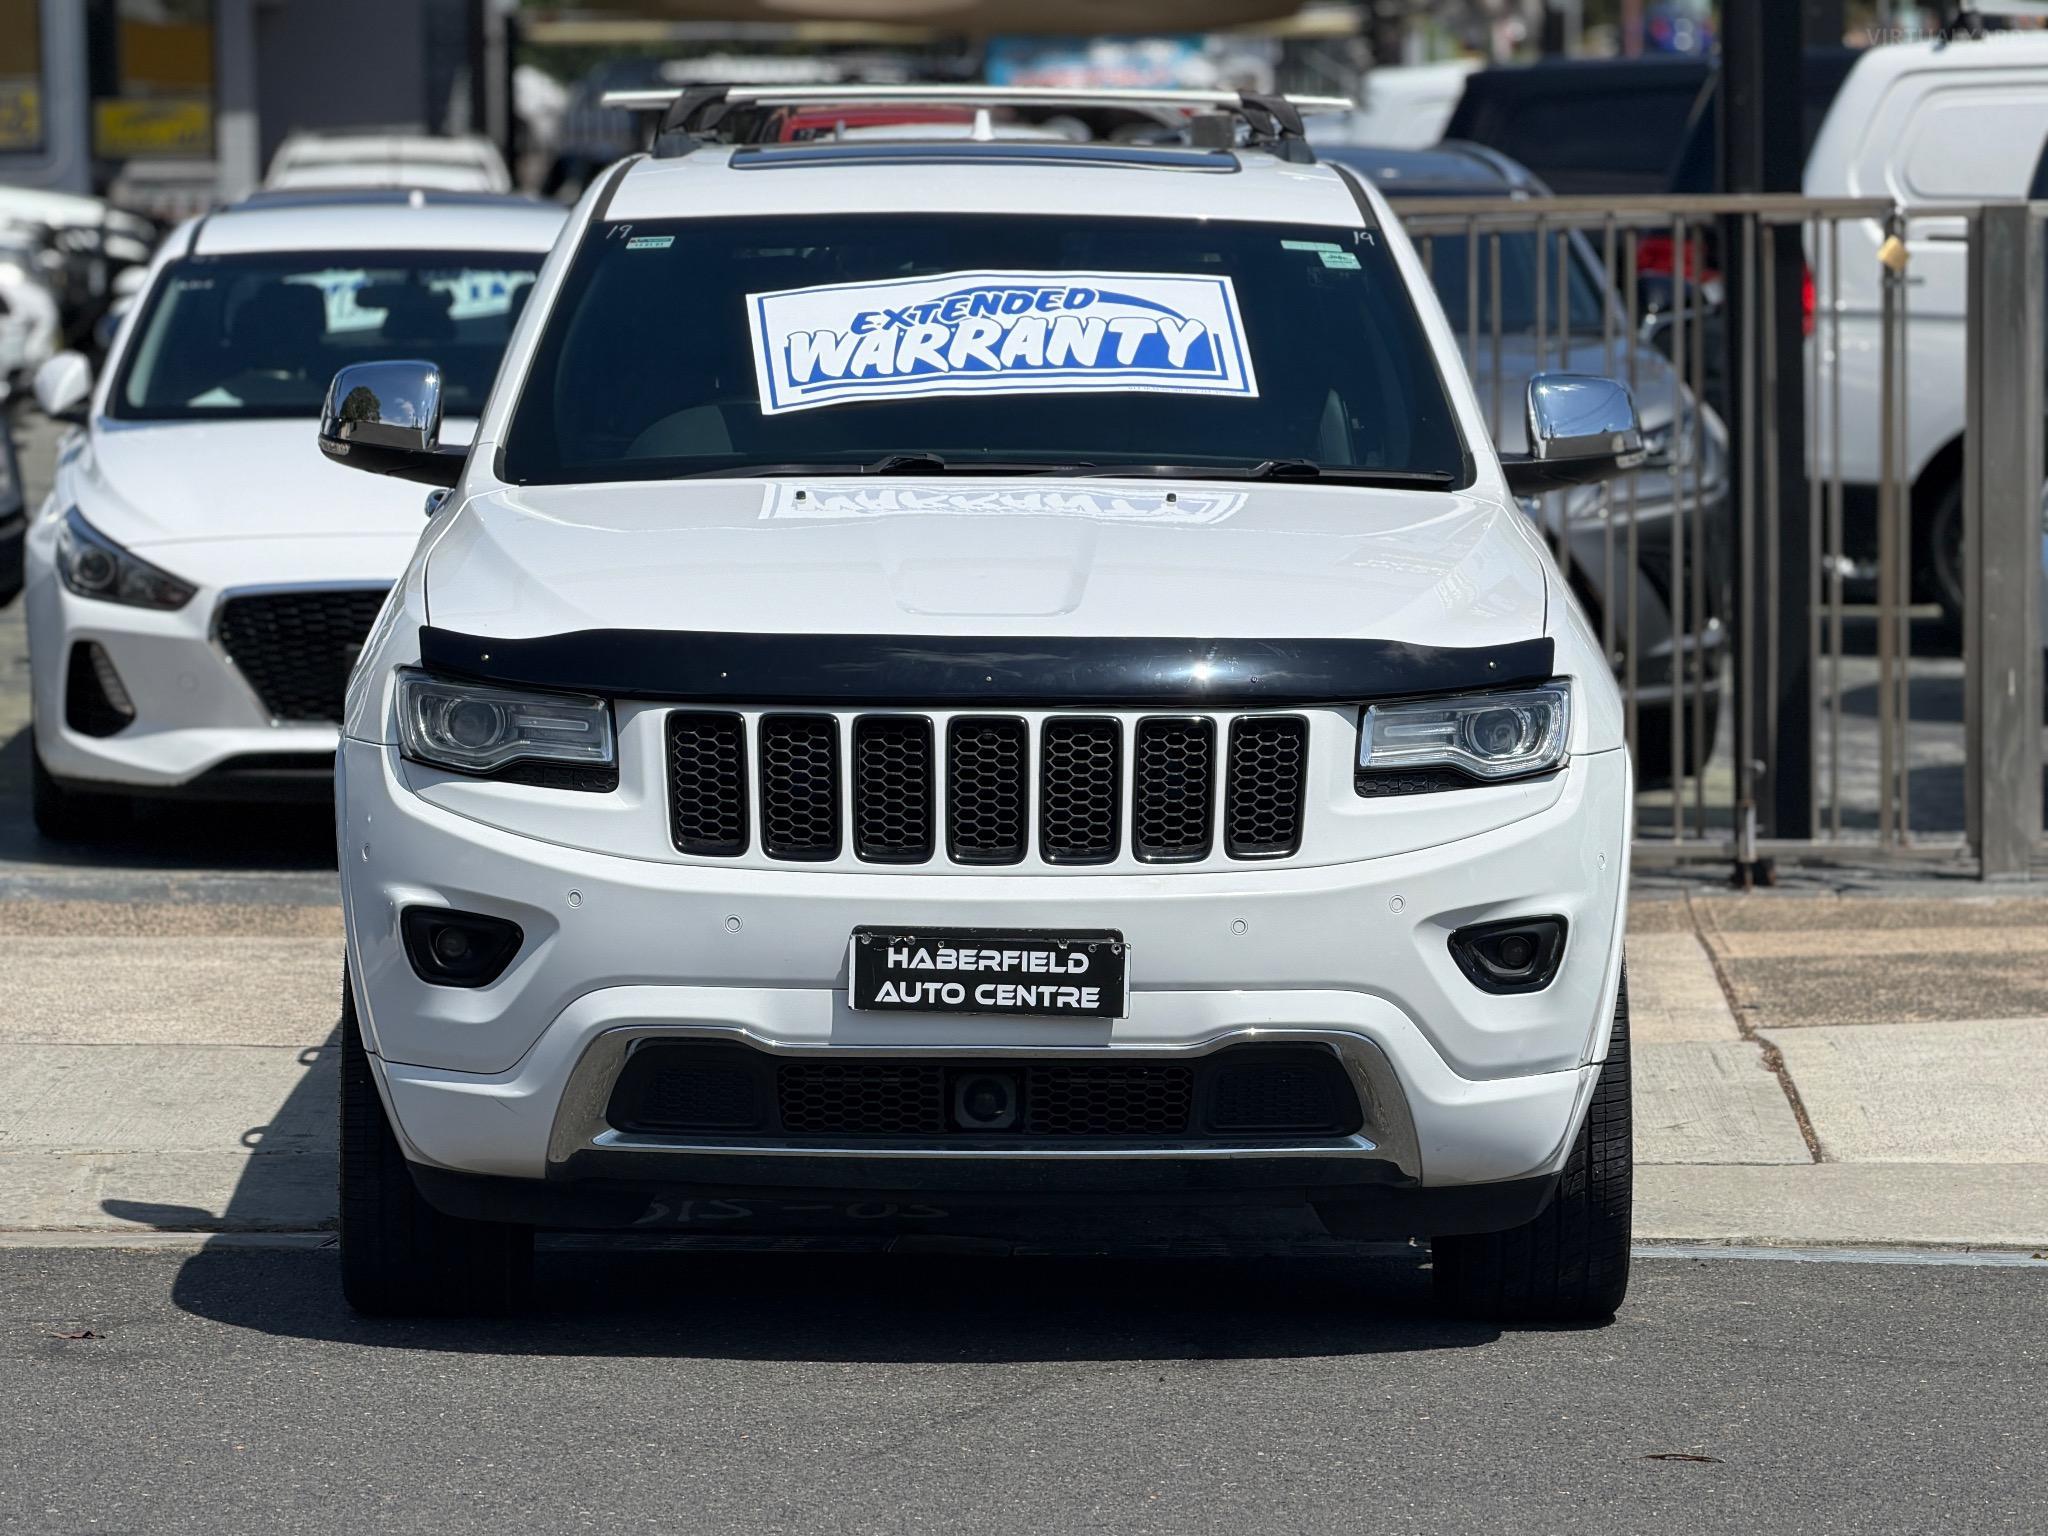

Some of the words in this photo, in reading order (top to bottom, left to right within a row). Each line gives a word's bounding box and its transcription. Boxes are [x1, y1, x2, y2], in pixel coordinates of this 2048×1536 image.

[605, 224, 633, 239] 19
[1353, 231, 1375, 246] 19
[851, 287, 1096, 335] EXTENDED
[788, 316, 1206, 382] WARRANTY
[887, 947, 1089, 974] HABERFIELD
[874, 980, 966, 1005] AUTO
[974, 983, 1101, 1009] CENTRE
